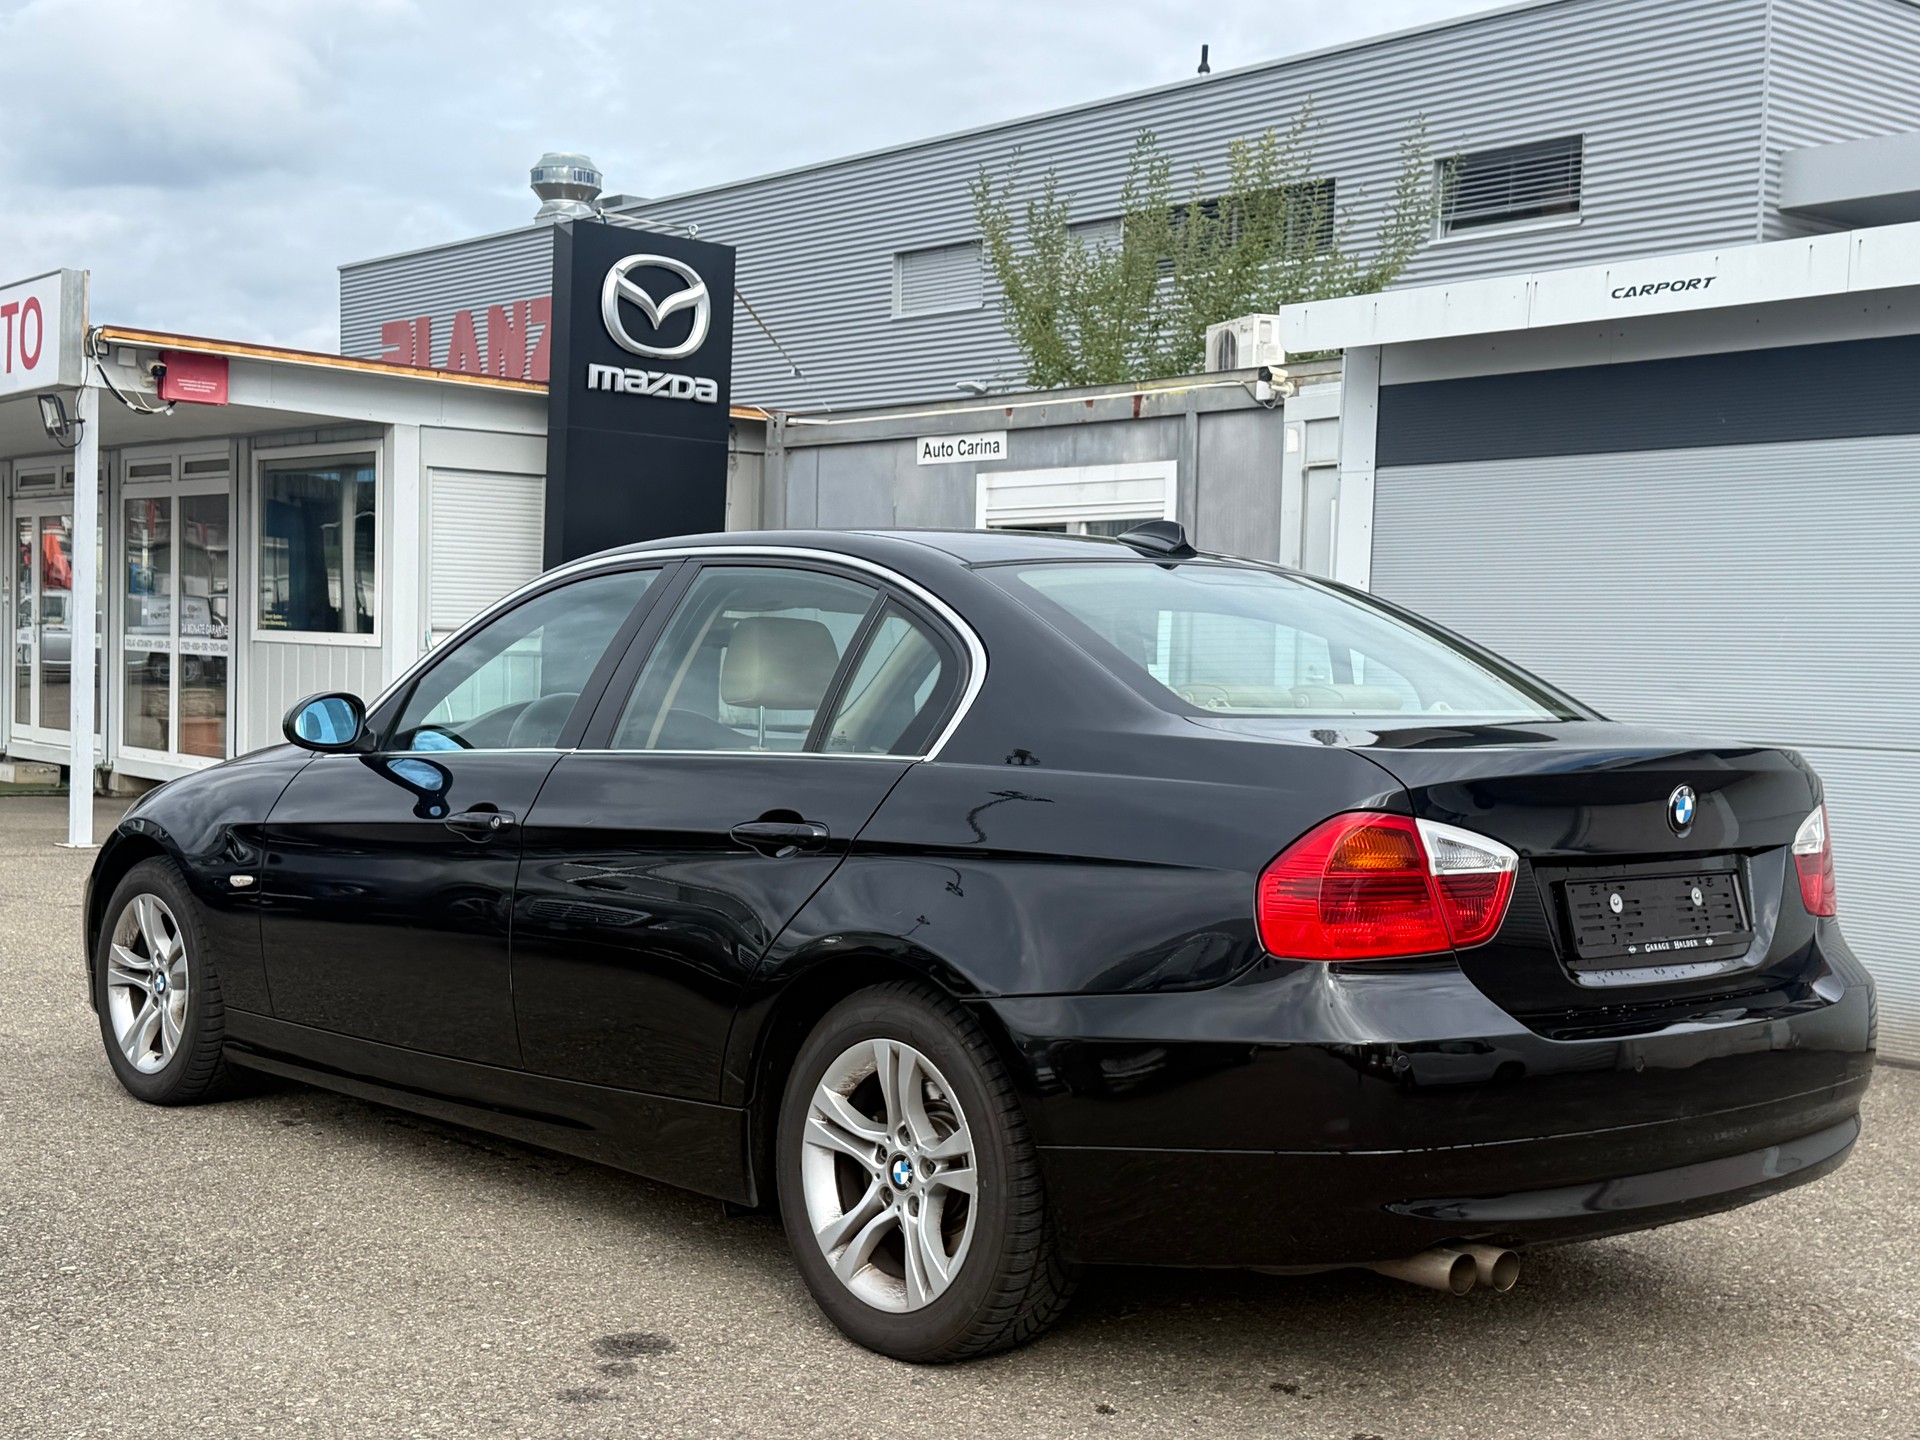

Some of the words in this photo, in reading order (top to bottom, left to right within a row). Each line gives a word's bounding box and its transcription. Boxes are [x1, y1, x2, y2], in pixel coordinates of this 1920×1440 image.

[1611, 276, 1717, 299] CARPORT
[0, 296, 43, 374] TO
[588, 363, 719, 403] mazda
[923, 442, 954, 458] Auto
[957, 438, 1000, 456] Carina
